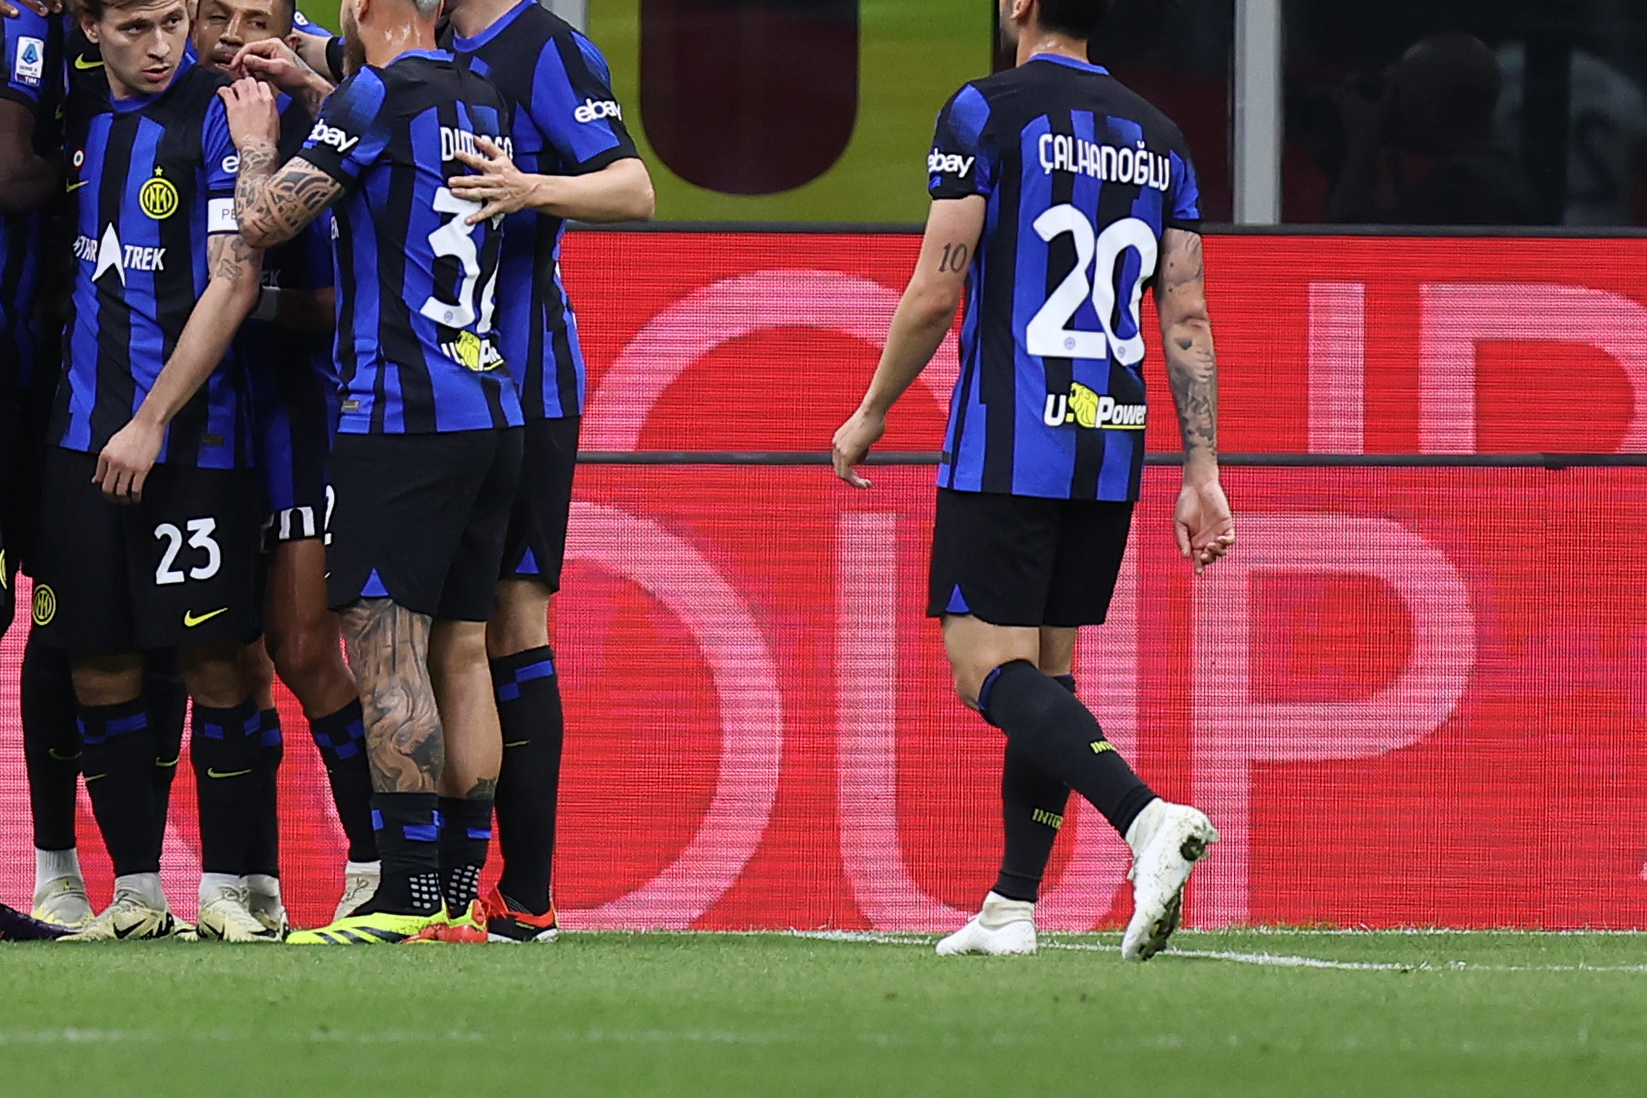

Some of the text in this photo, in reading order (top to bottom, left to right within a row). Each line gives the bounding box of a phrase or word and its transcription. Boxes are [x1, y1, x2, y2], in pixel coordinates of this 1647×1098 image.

[574, 98, 622, 123] ebay
[1038, 133, 1171, 192] ÇALHANOĞLU
[123, 243, 166, 271] TREK
[938, 243, 968, 273] 10
[1026, 202, 1159, 367] 20
[154, 517, 222, 585] 23
